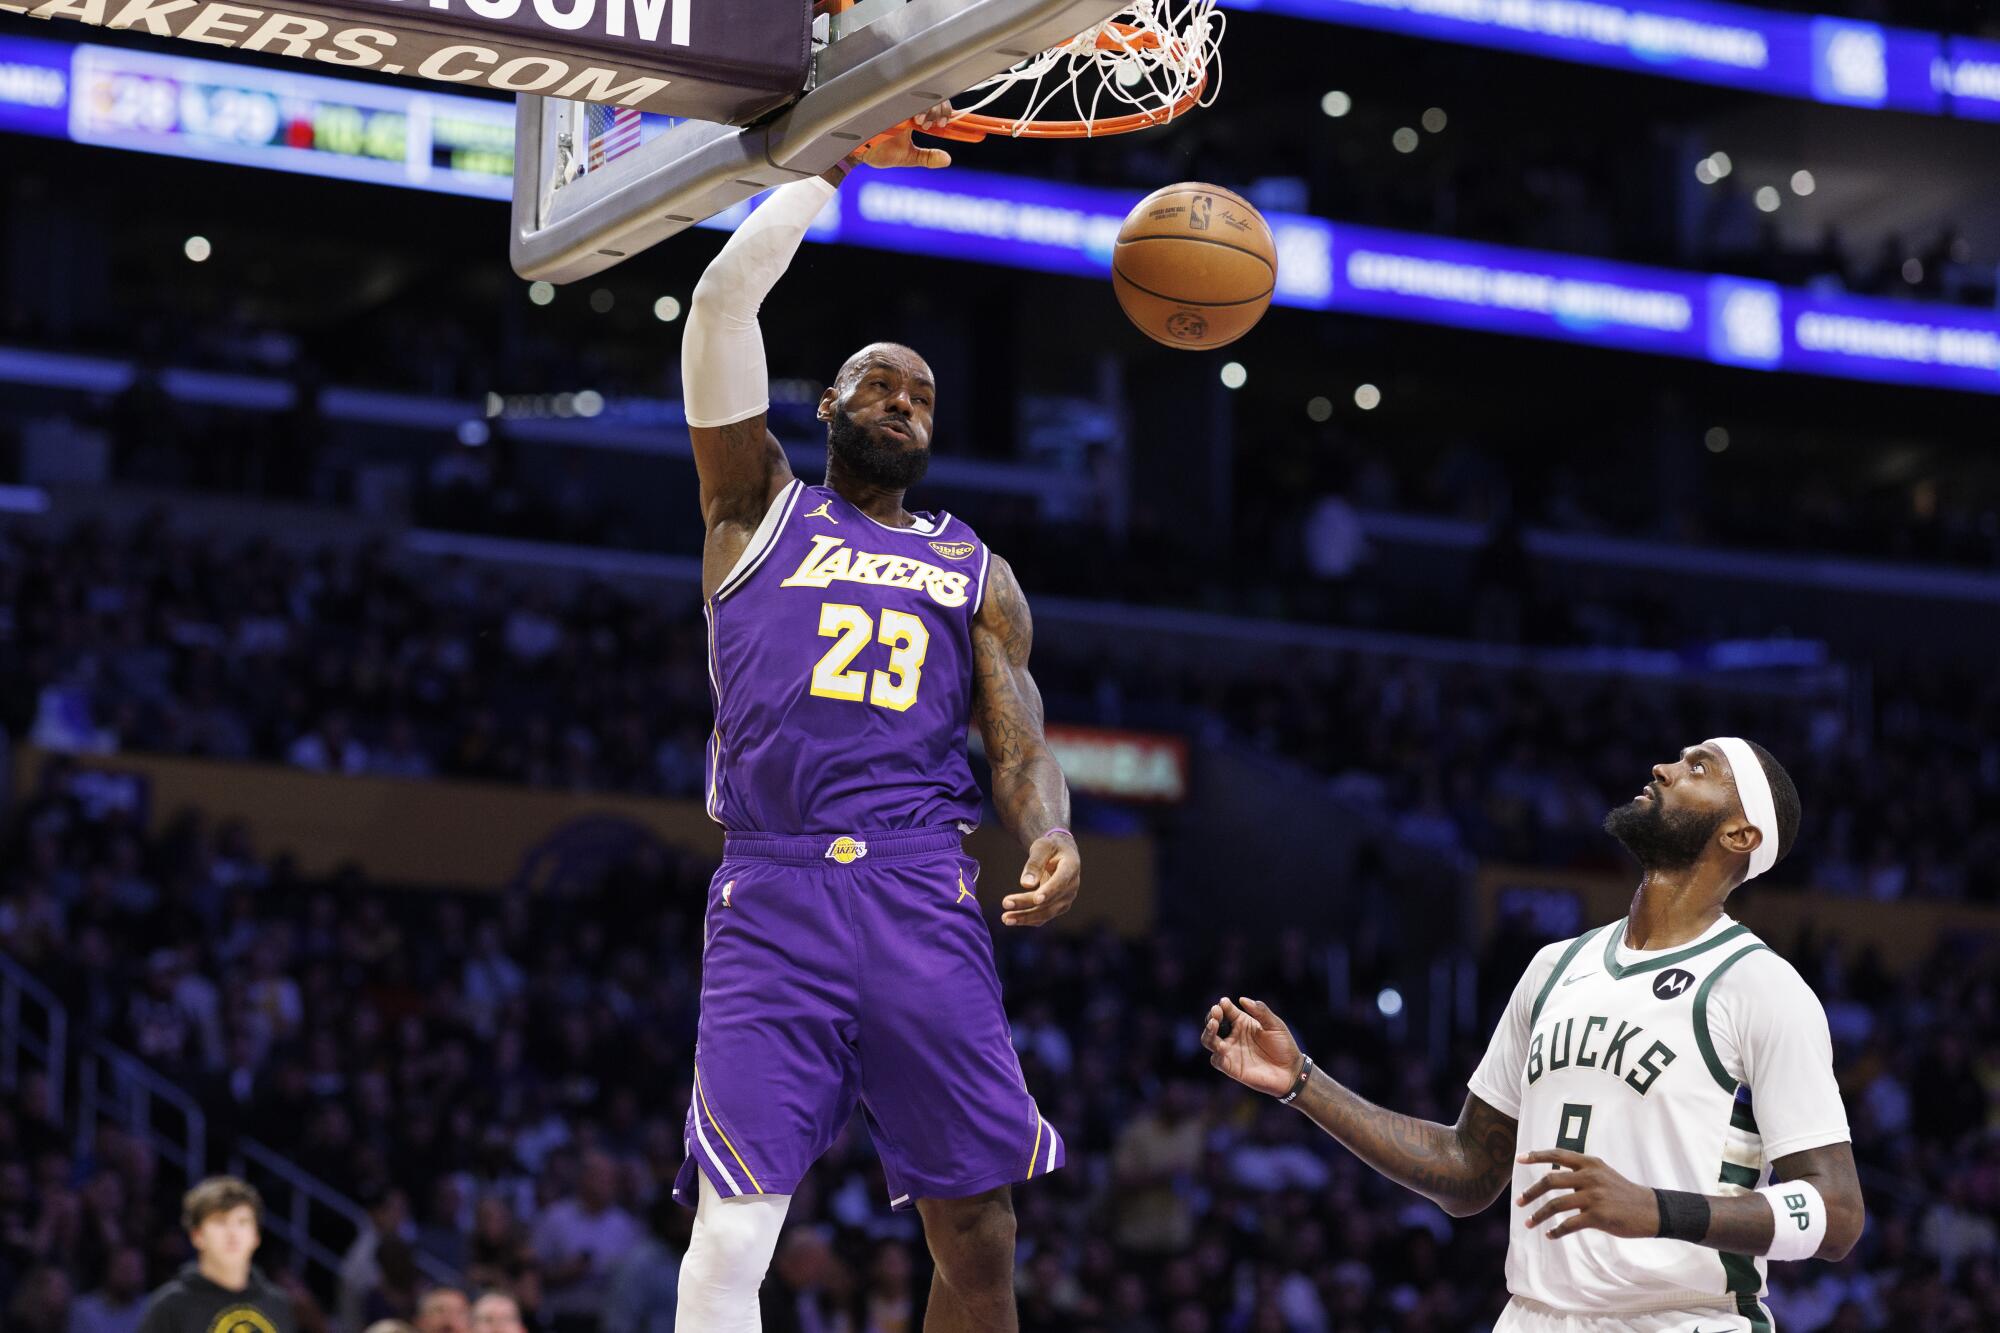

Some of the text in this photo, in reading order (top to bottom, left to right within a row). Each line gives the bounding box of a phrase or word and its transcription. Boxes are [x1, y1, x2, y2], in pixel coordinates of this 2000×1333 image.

[0, 0, 671, 106] AKERS.COM
[780, 534, 969, 608] LAKERS
[810, 602, 930, 712] 23
[825, 842, 867, 858] LAKERS
[1528, 1015, 1678, 1096] BUCKS
[1783, 1193, 1810, 1231] BP
